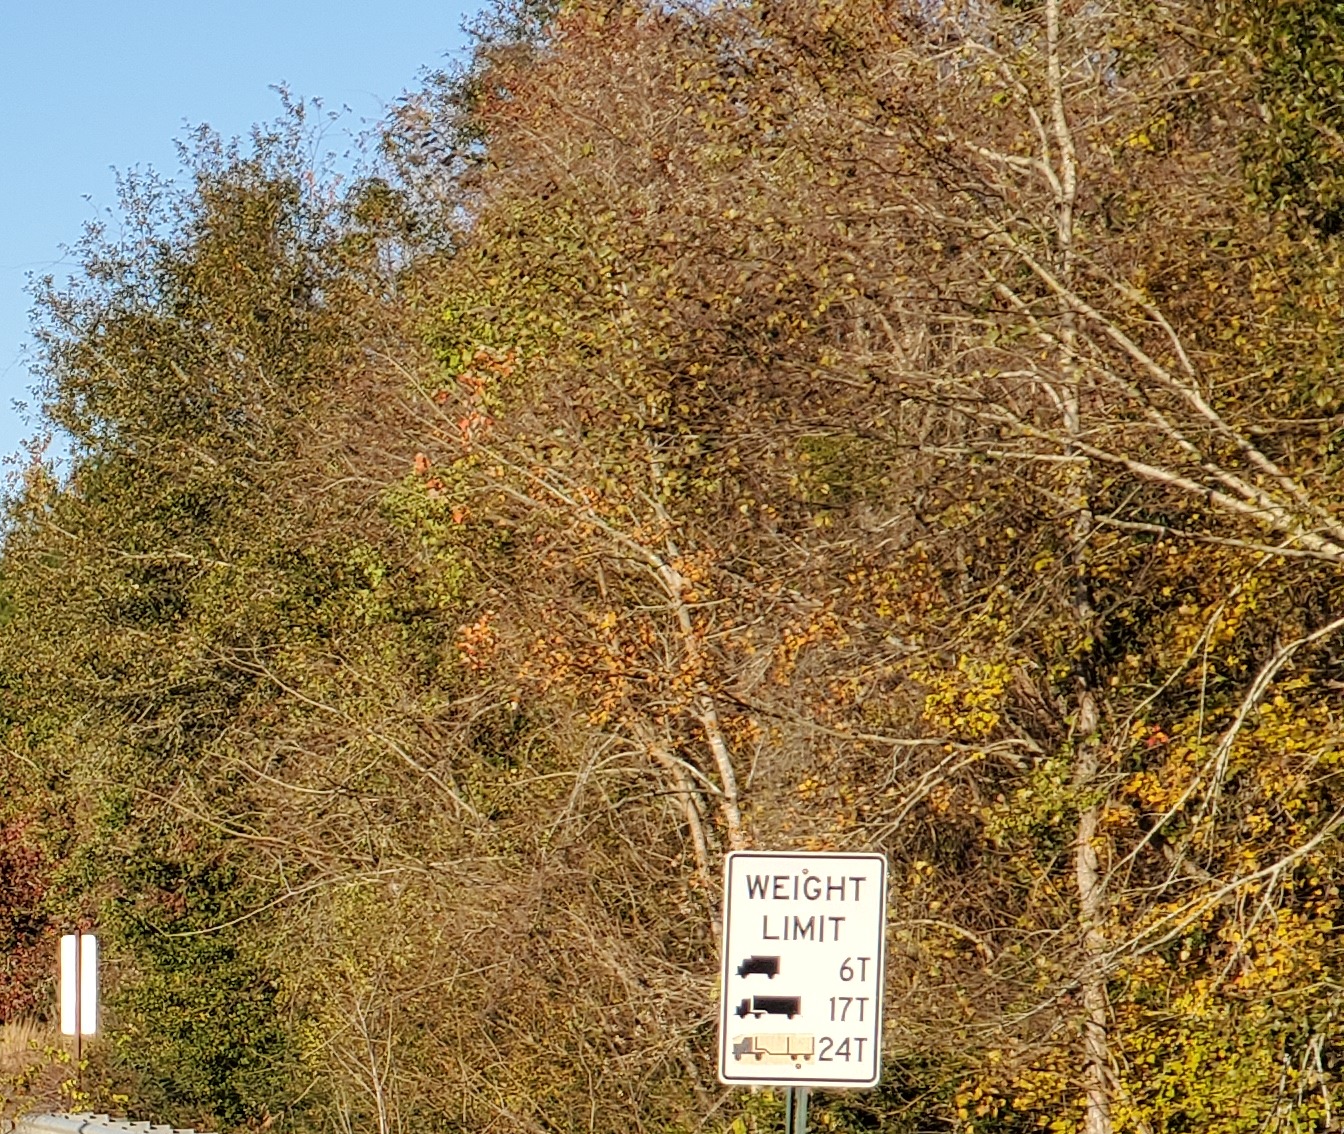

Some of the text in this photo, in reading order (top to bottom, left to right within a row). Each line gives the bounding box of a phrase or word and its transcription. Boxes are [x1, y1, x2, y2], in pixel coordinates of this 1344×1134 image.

[746, 875, 866, 901] WEIGHT
[763, 915, 846, 942] LIMIT
[839, 957, 871, 982] 6T
[829, 997, 869, 1021] 17T
[818, 1036, 868, 1062] 24T
